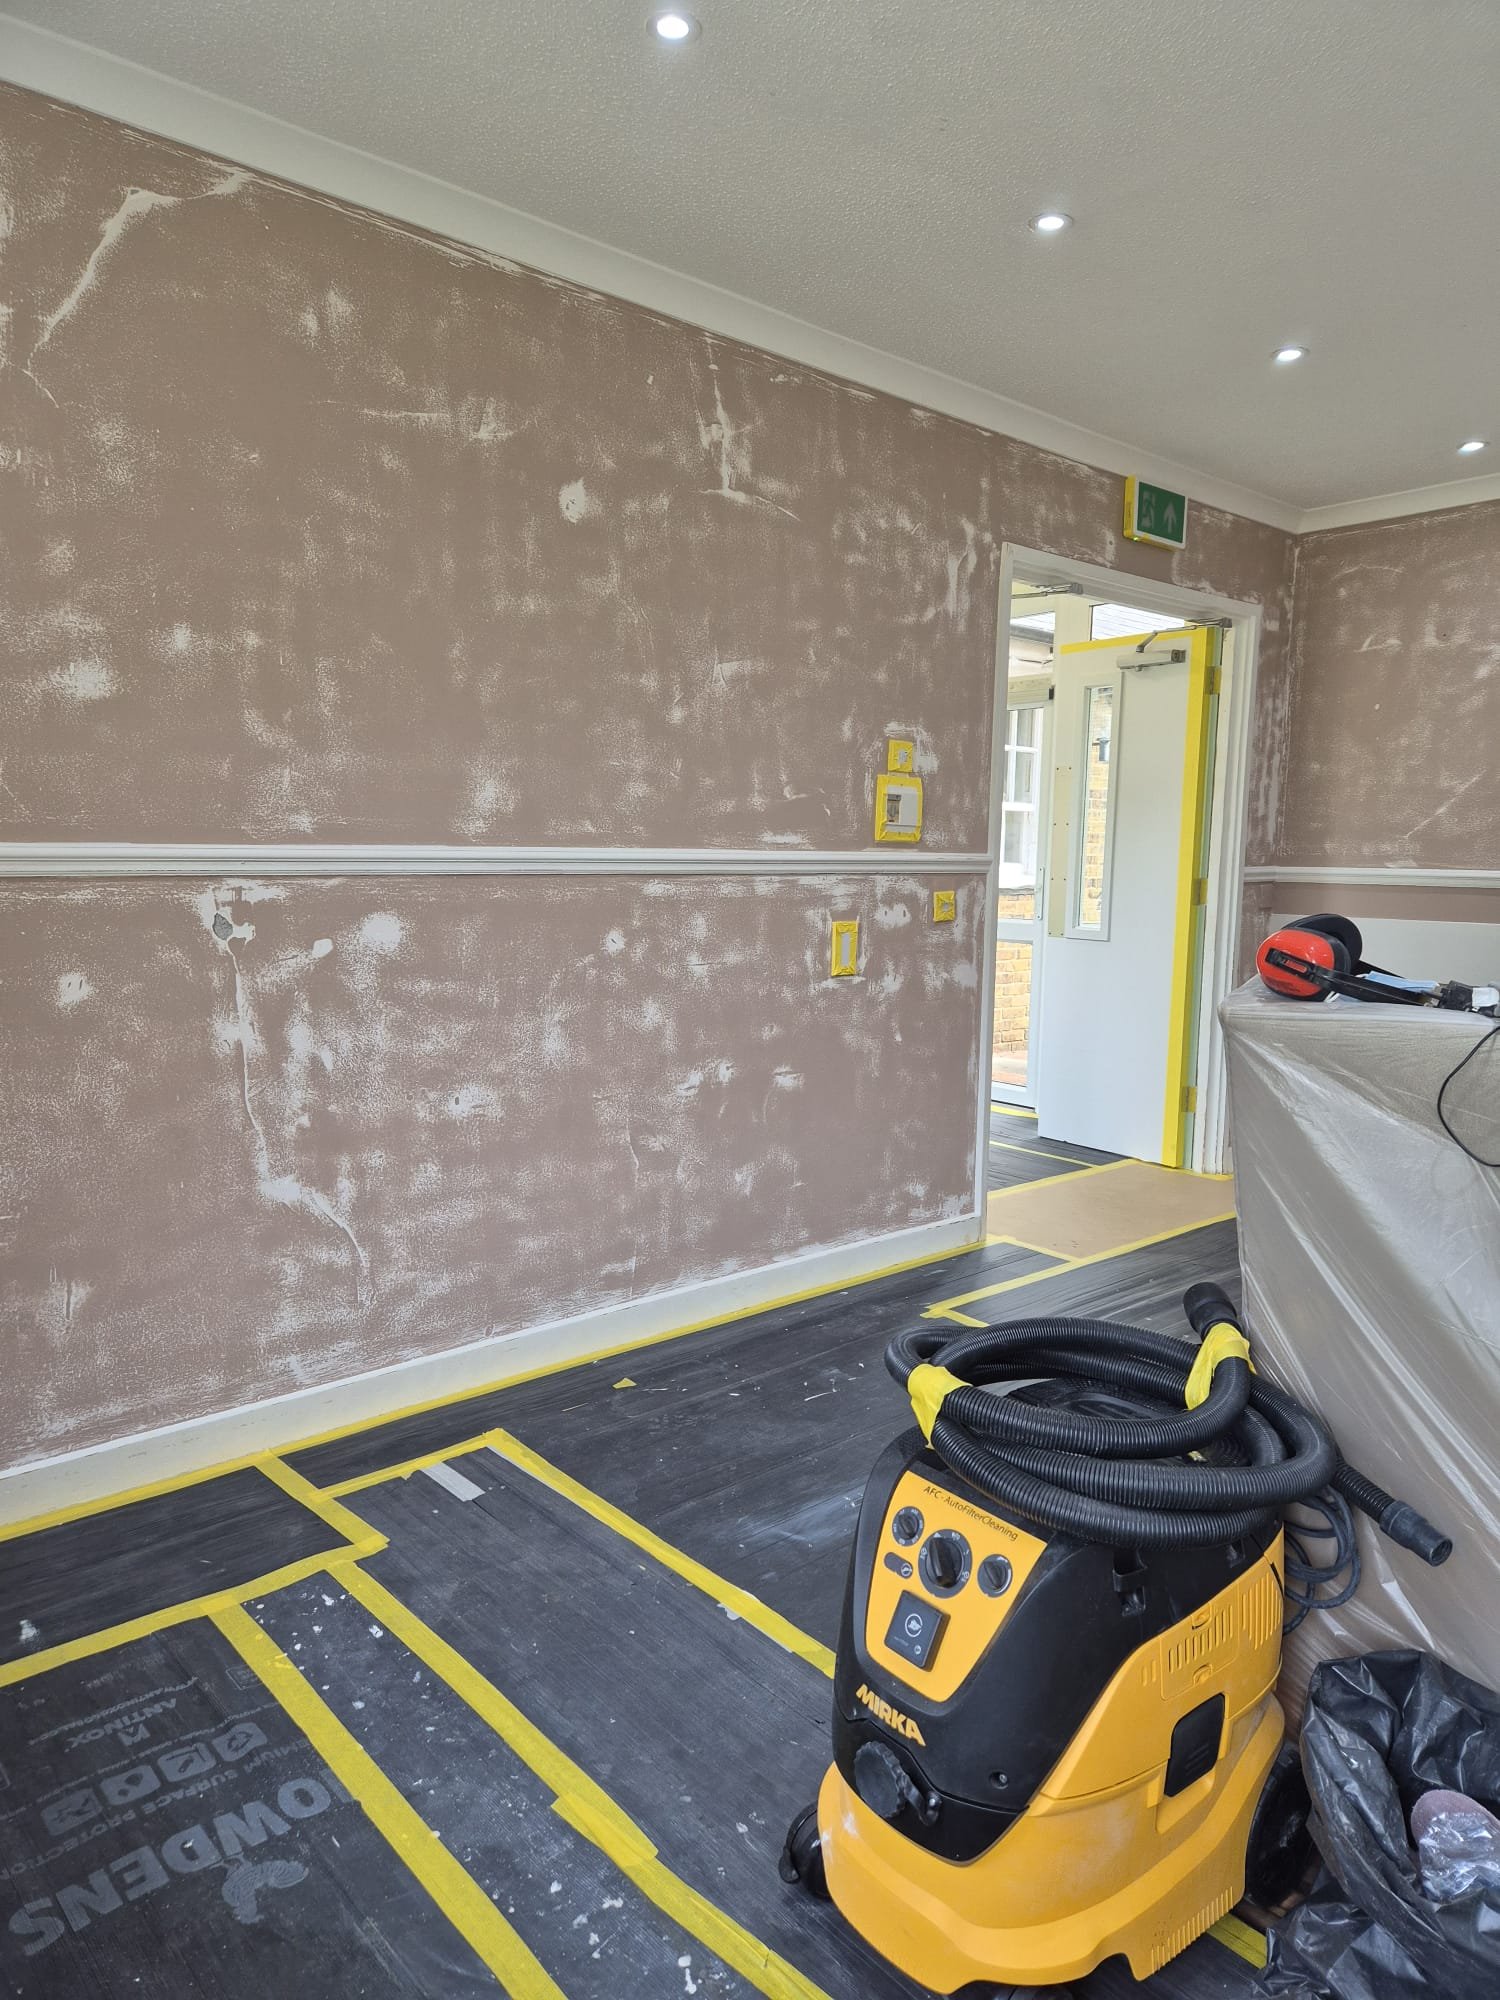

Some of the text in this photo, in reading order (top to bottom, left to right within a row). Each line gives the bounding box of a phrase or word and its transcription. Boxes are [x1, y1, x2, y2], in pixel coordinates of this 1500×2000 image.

[923, 1486, 942, 1499] AFC
[944, 1497, 1018, 1541] AutoFilterCleaning
[69, 1699, 178, 1749] ANTINOX
[855, 1683, 926, 1747] MIRKA
[142, 1768, 239, 1815] SURFACE
